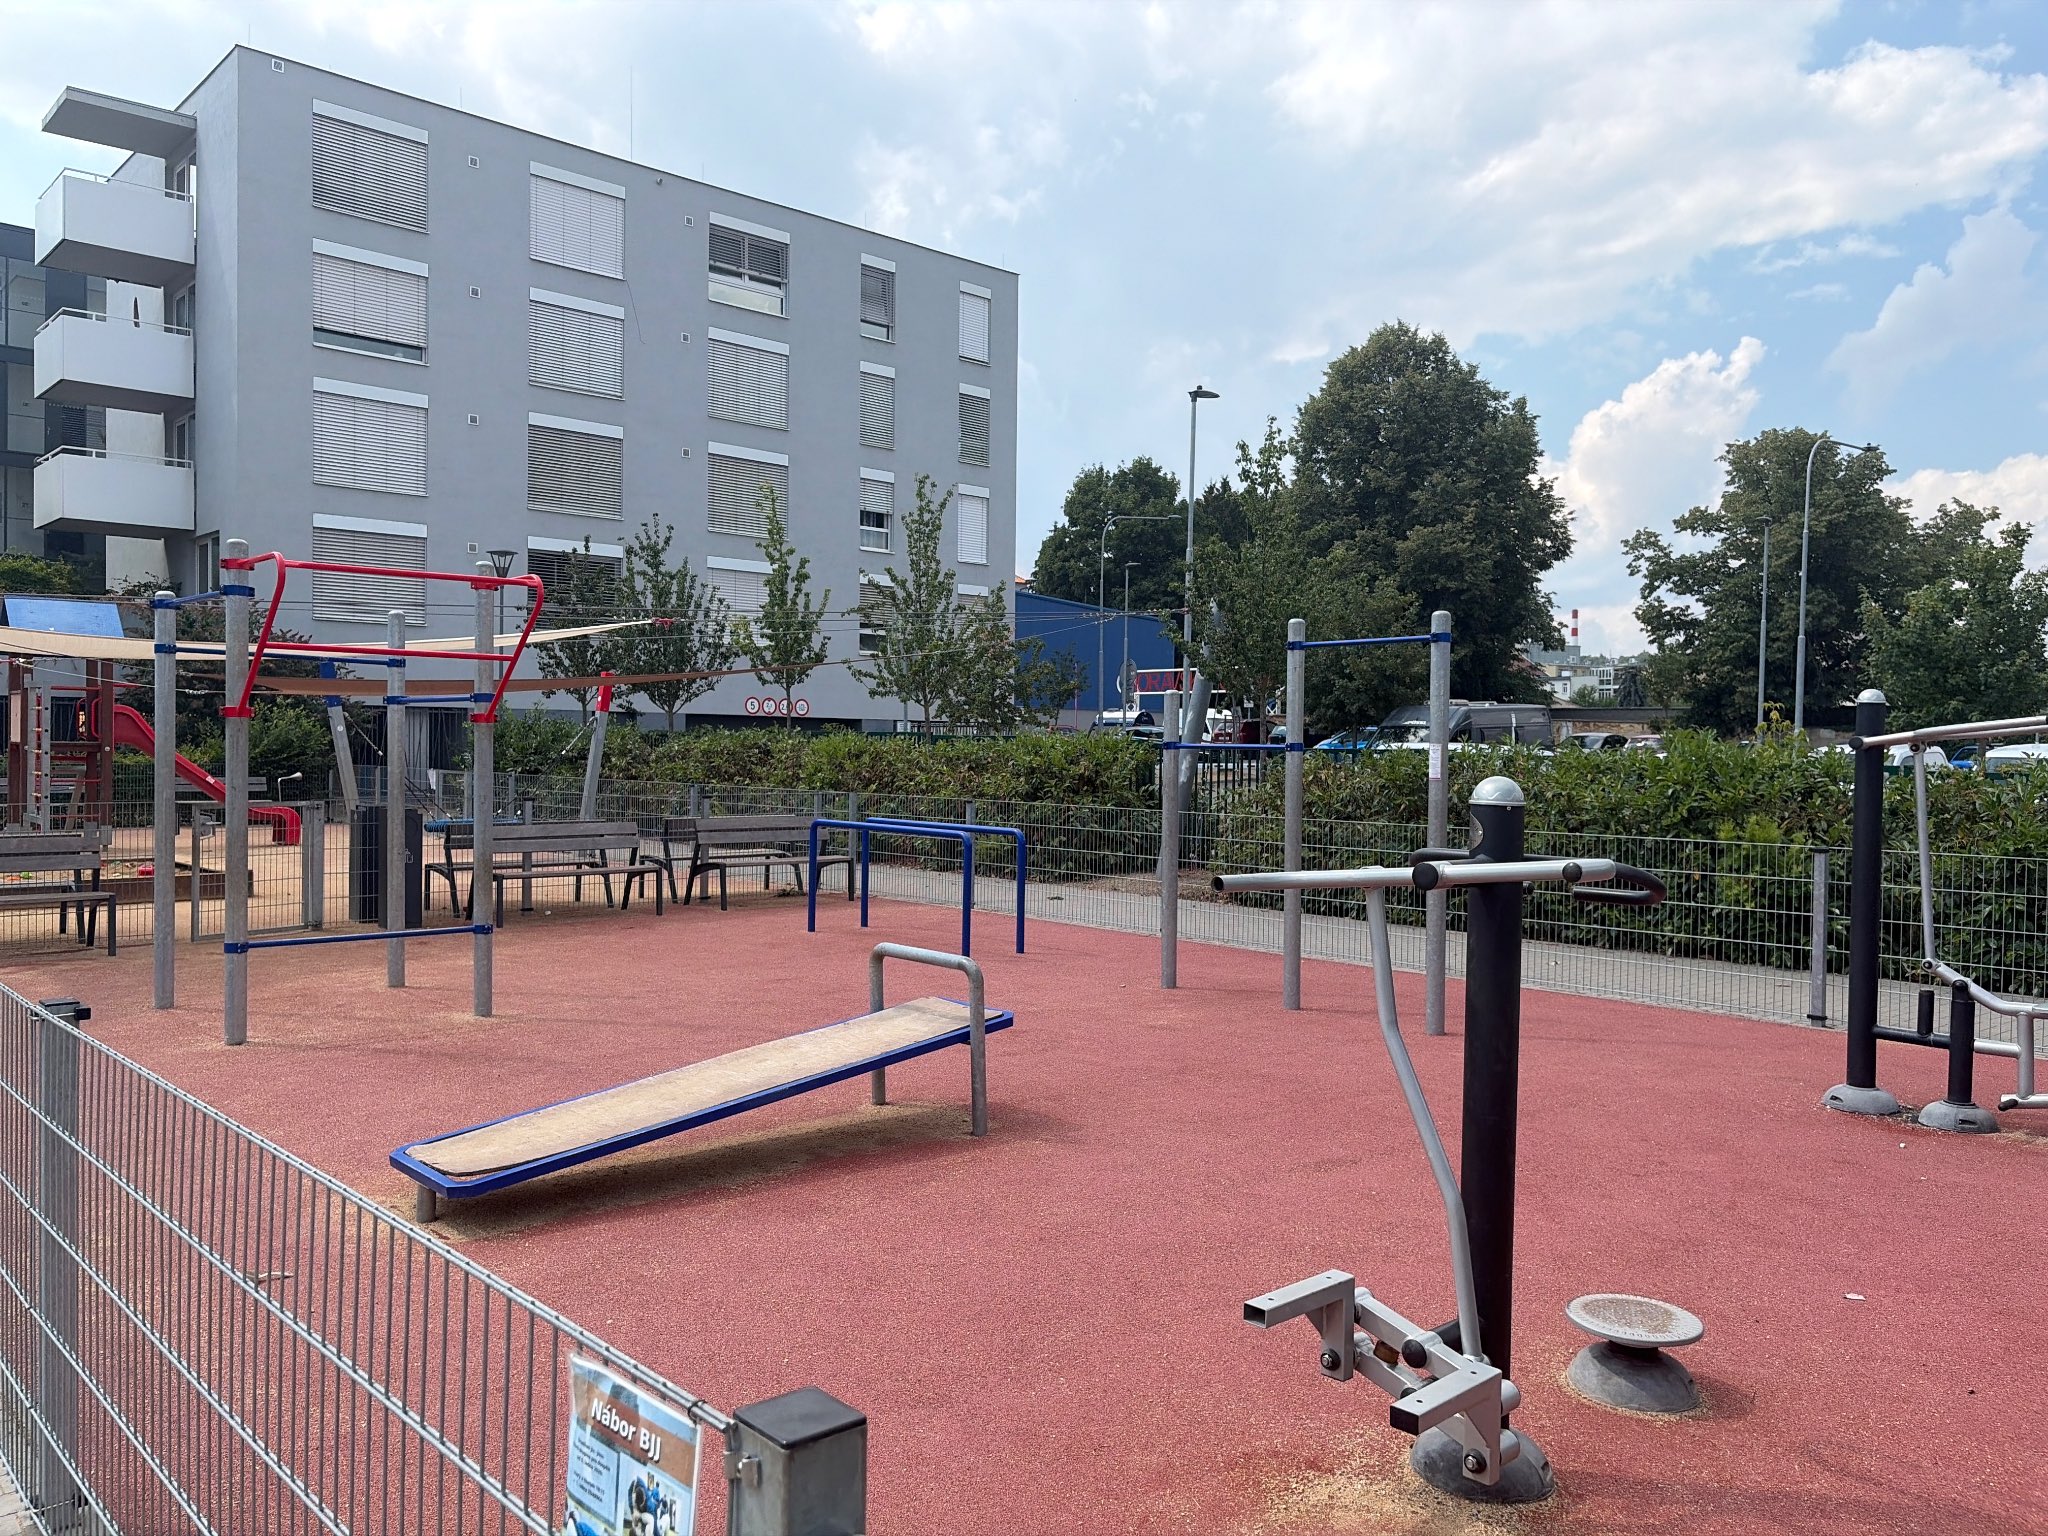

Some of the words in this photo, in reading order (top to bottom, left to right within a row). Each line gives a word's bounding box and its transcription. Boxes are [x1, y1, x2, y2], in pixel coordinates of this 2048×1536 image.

[750, 701, 756, 710] 5
[591, 1398, 636, 1441] Nábor
[639, 1427, 662, 1461] BJJ
